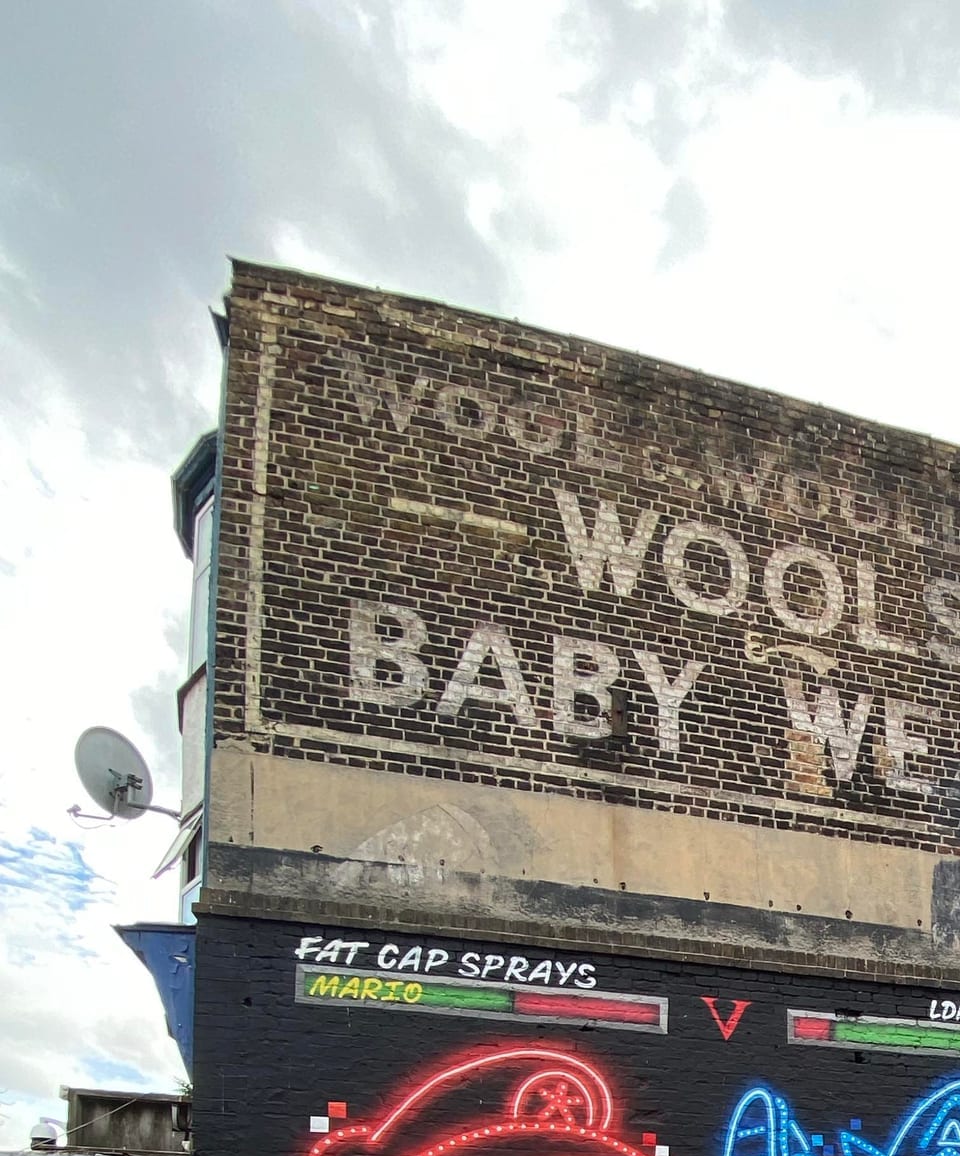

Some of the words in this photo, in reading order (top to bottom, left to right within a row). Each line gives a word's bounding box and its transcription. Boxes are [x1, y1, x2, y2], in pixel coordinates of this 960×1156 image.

[349, 600, 708, 754] BABY
[294, 936, 370, 966] FAT
[377, 944, 449, 973] CAP
[457, 951, 598, 989] SPRAYS
[309, 973, 424, 1004] MARIO
[701, 996, 752, 1042] V
